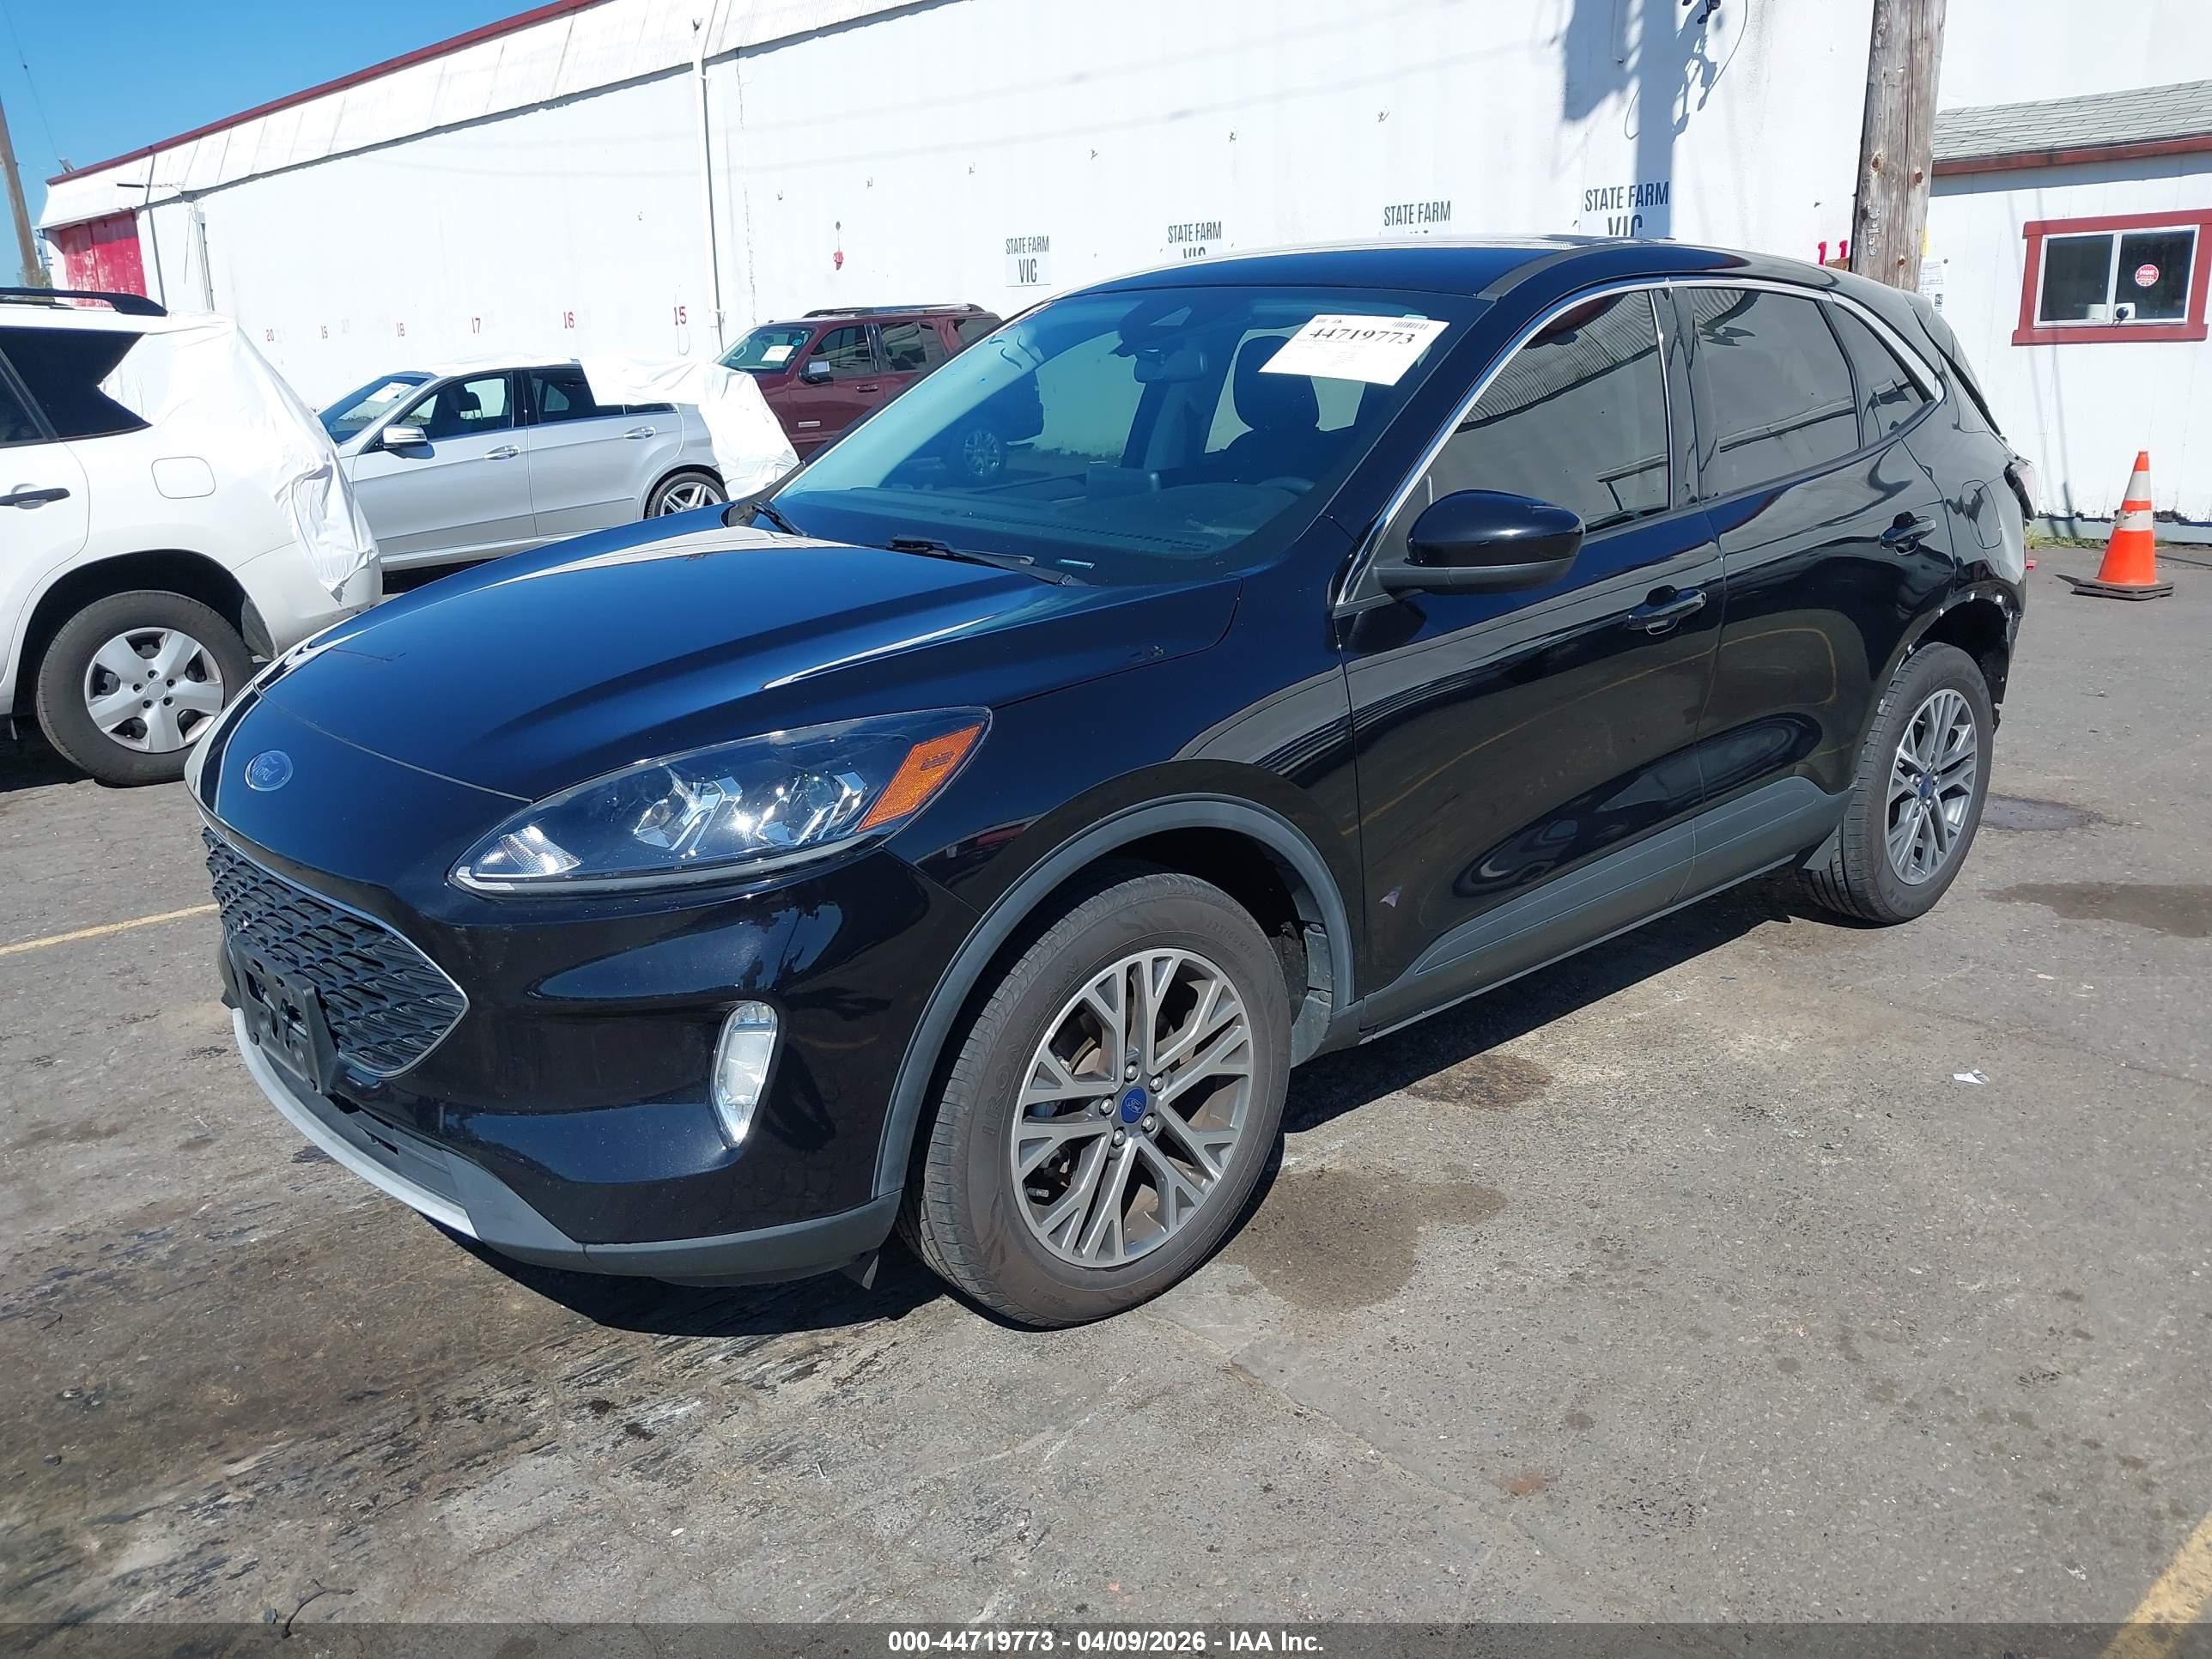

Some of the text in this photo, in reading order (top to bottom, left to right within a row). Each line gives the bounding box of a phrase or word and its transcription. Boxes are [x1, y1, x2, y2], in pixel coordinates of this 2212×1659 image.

[1585, 181, 1668, 212] STATE FARM
[1384, 200, 1450, 226] STATE FARM
[1168, 221, 1221, 243] STATE FARM
[1006, 235, 1049, 254] STATE FARM
[1018, 258, 1037, 283] VIC
[564, 312, 574, 328] 16
[674, 307, 686, 325] 15
[397, 323, 405, 337] 18
[471, 318, 481, 333] 17
[266, 329, 275, 342] 20
[1310, 328, 1415, 344] 44719773
